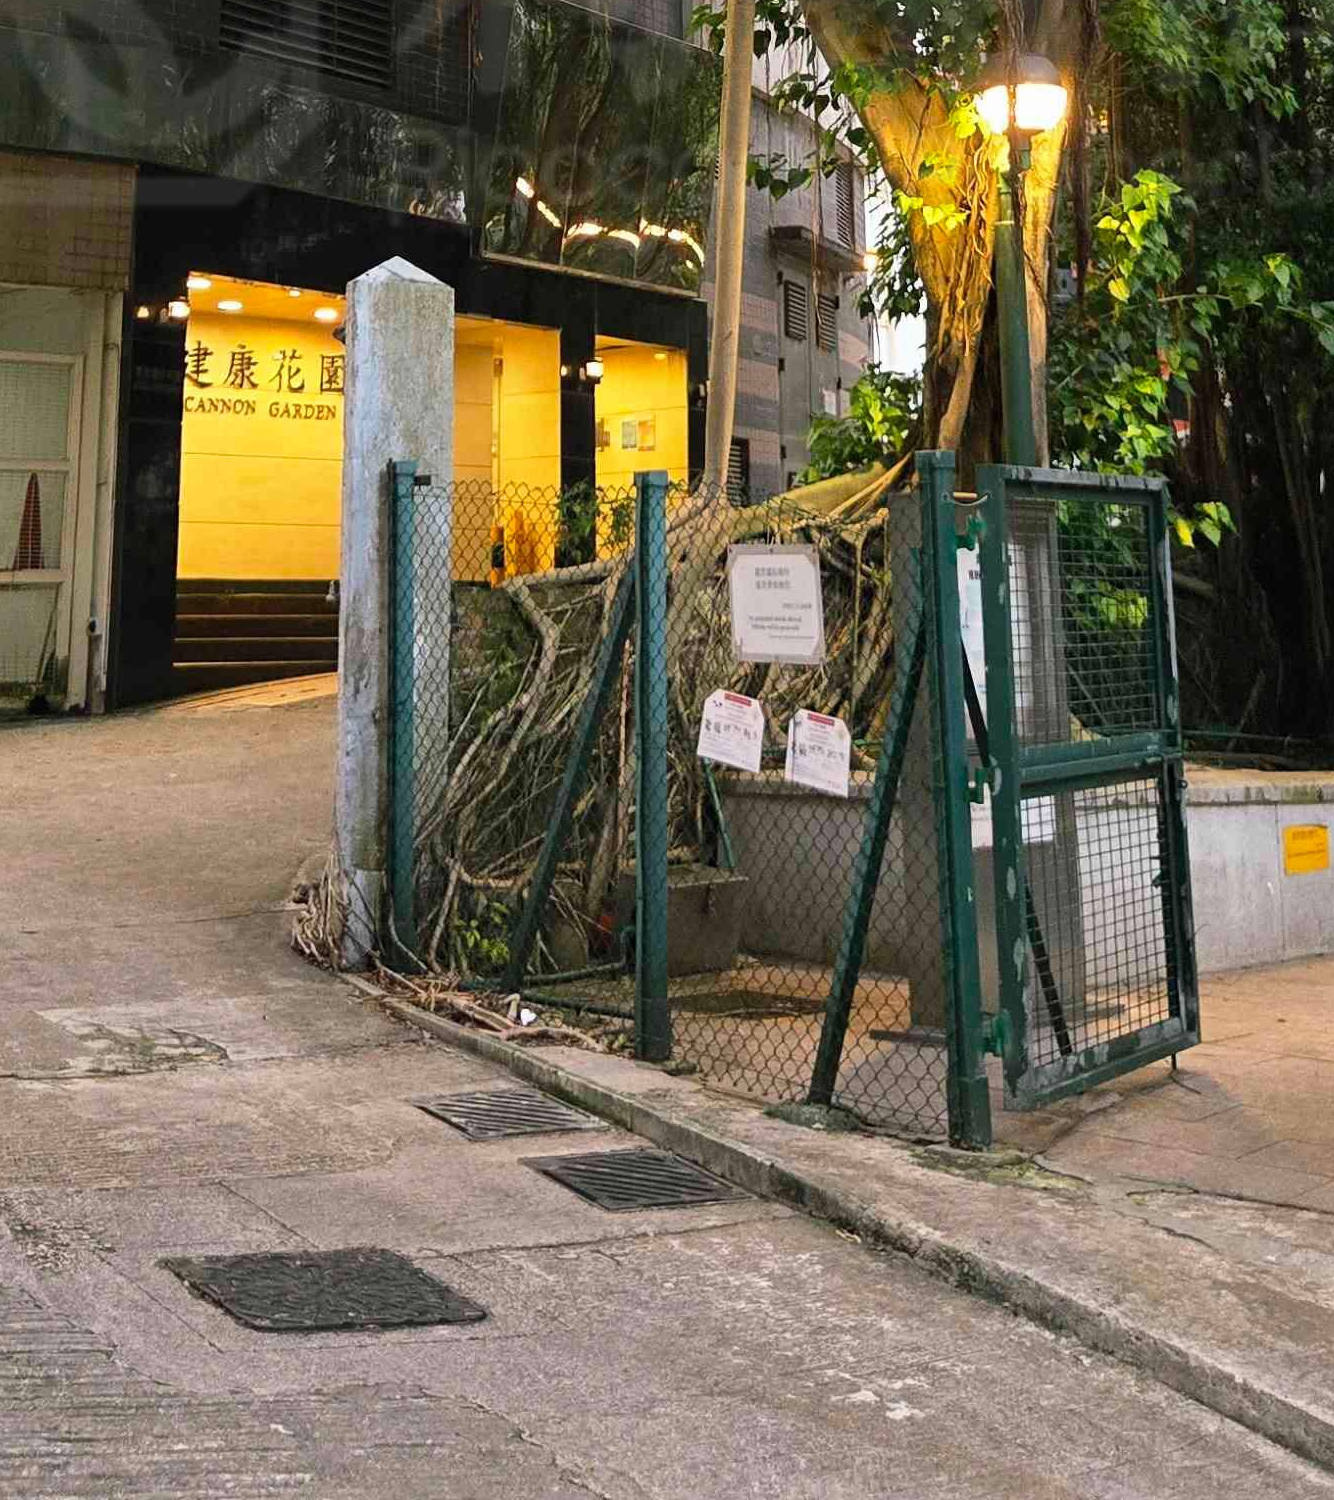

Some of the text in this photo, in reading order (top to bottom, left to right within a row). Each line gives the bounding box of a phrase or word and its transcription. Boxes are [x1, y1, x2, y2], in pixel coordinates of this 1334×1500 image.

[185, 341, 346, 395] 建康花園
[185, 396, 337, 420] CANNON GARDEN
